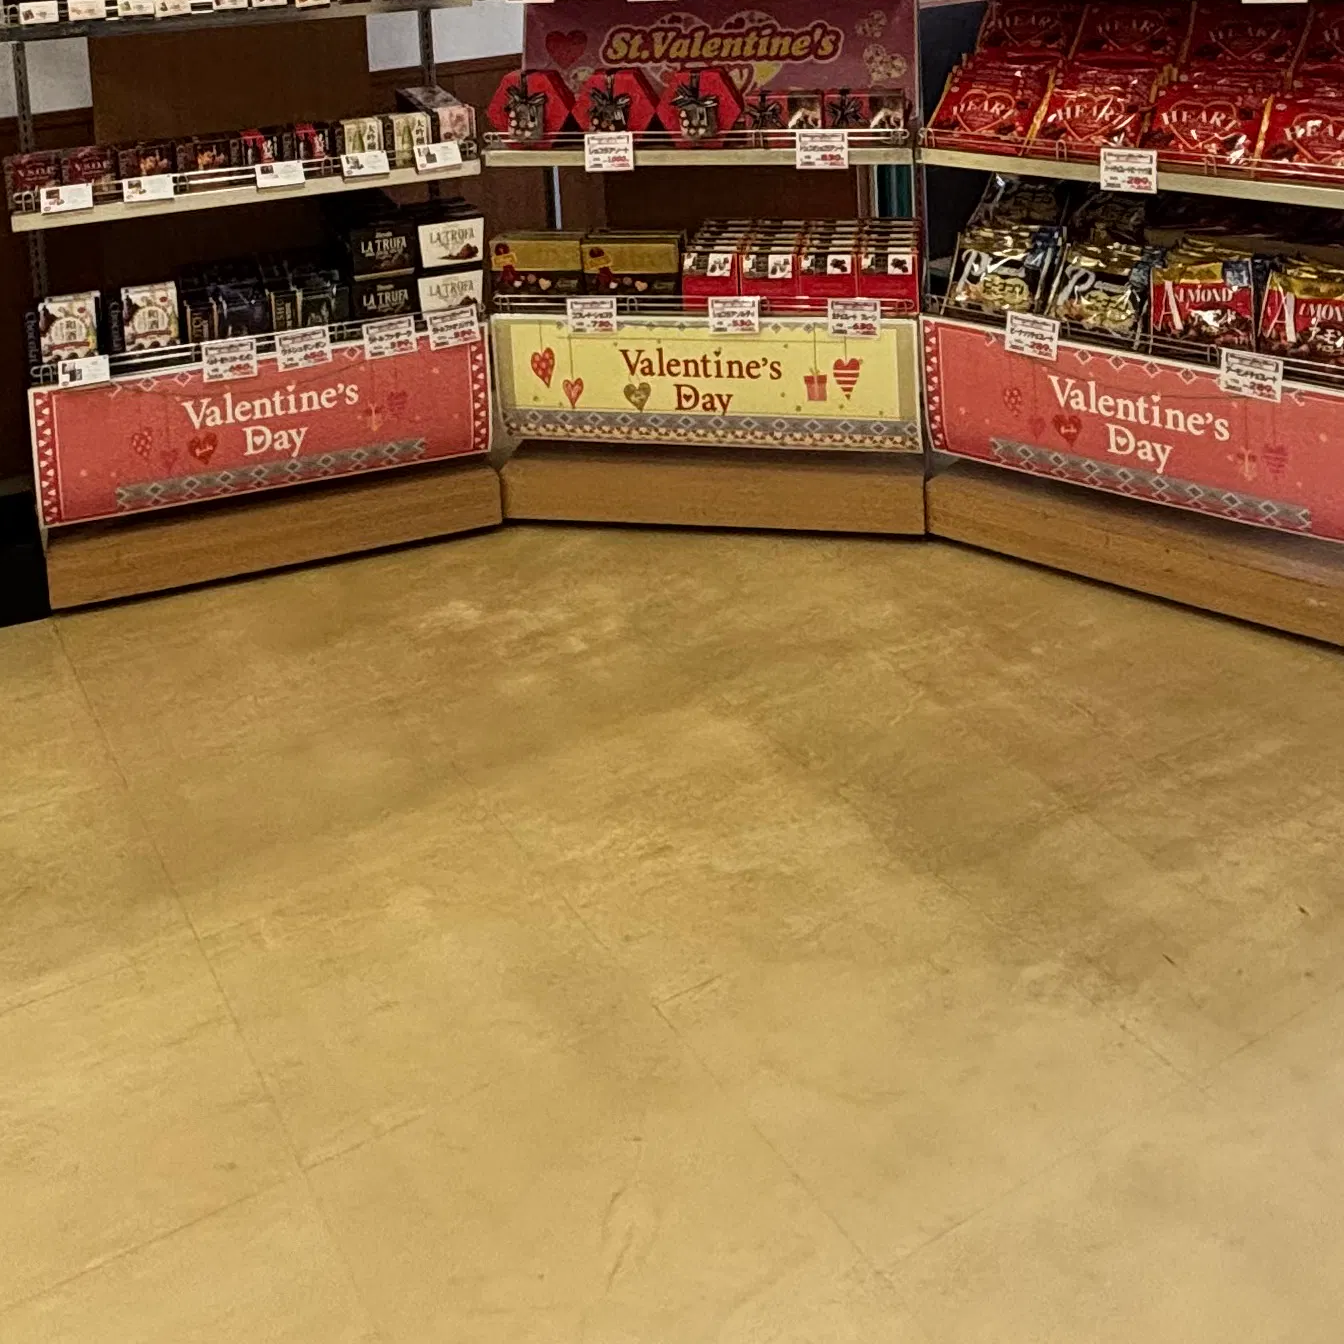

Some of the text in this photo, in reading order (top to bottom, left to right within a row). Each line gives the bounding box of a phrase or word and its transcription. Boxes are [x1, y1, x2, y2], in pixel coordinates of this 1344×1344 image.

[375, 235, 407, 253] TRUFA
[376, 288, 409, 305] TRUFA
[619, 347, 783, 382] Valentine's
[181, 382, 360, 431] Valentine's
[672, 383, 734, 416] Day
[1048, 374, 1230, 442] Valentine's
[242, 426, 309, 458] Day
[1106, 423, 1173, 474] Day
